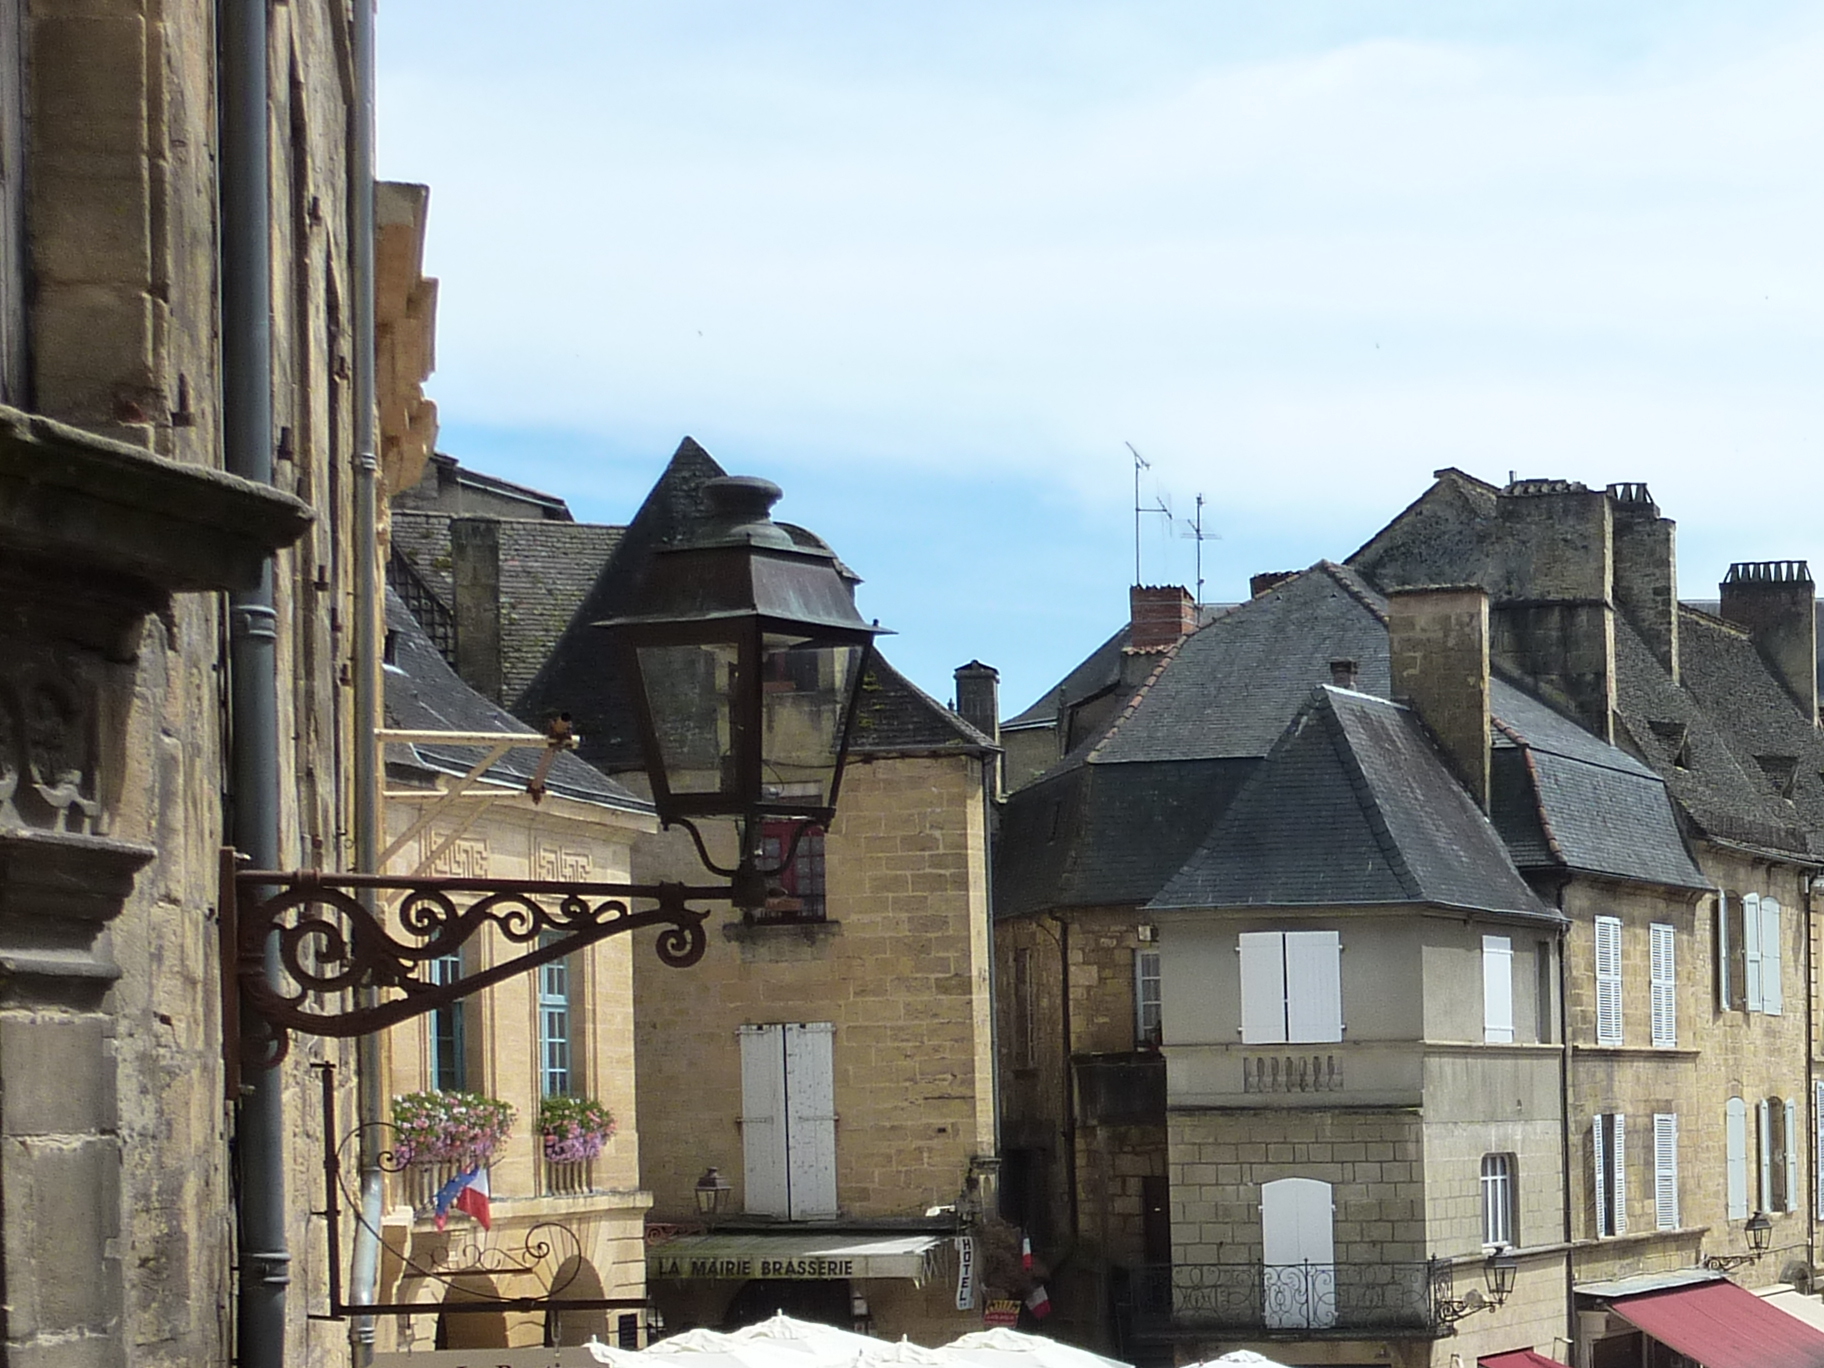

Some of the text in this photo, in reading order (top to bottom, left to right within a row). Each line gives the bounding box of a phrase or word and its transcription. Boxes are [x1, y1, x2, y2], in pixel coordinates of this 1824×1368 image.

[659, 1260, 853, 1276] LA MAIRIE BRASSERIE
[958, 1238, 971, 1302] HOTEL
